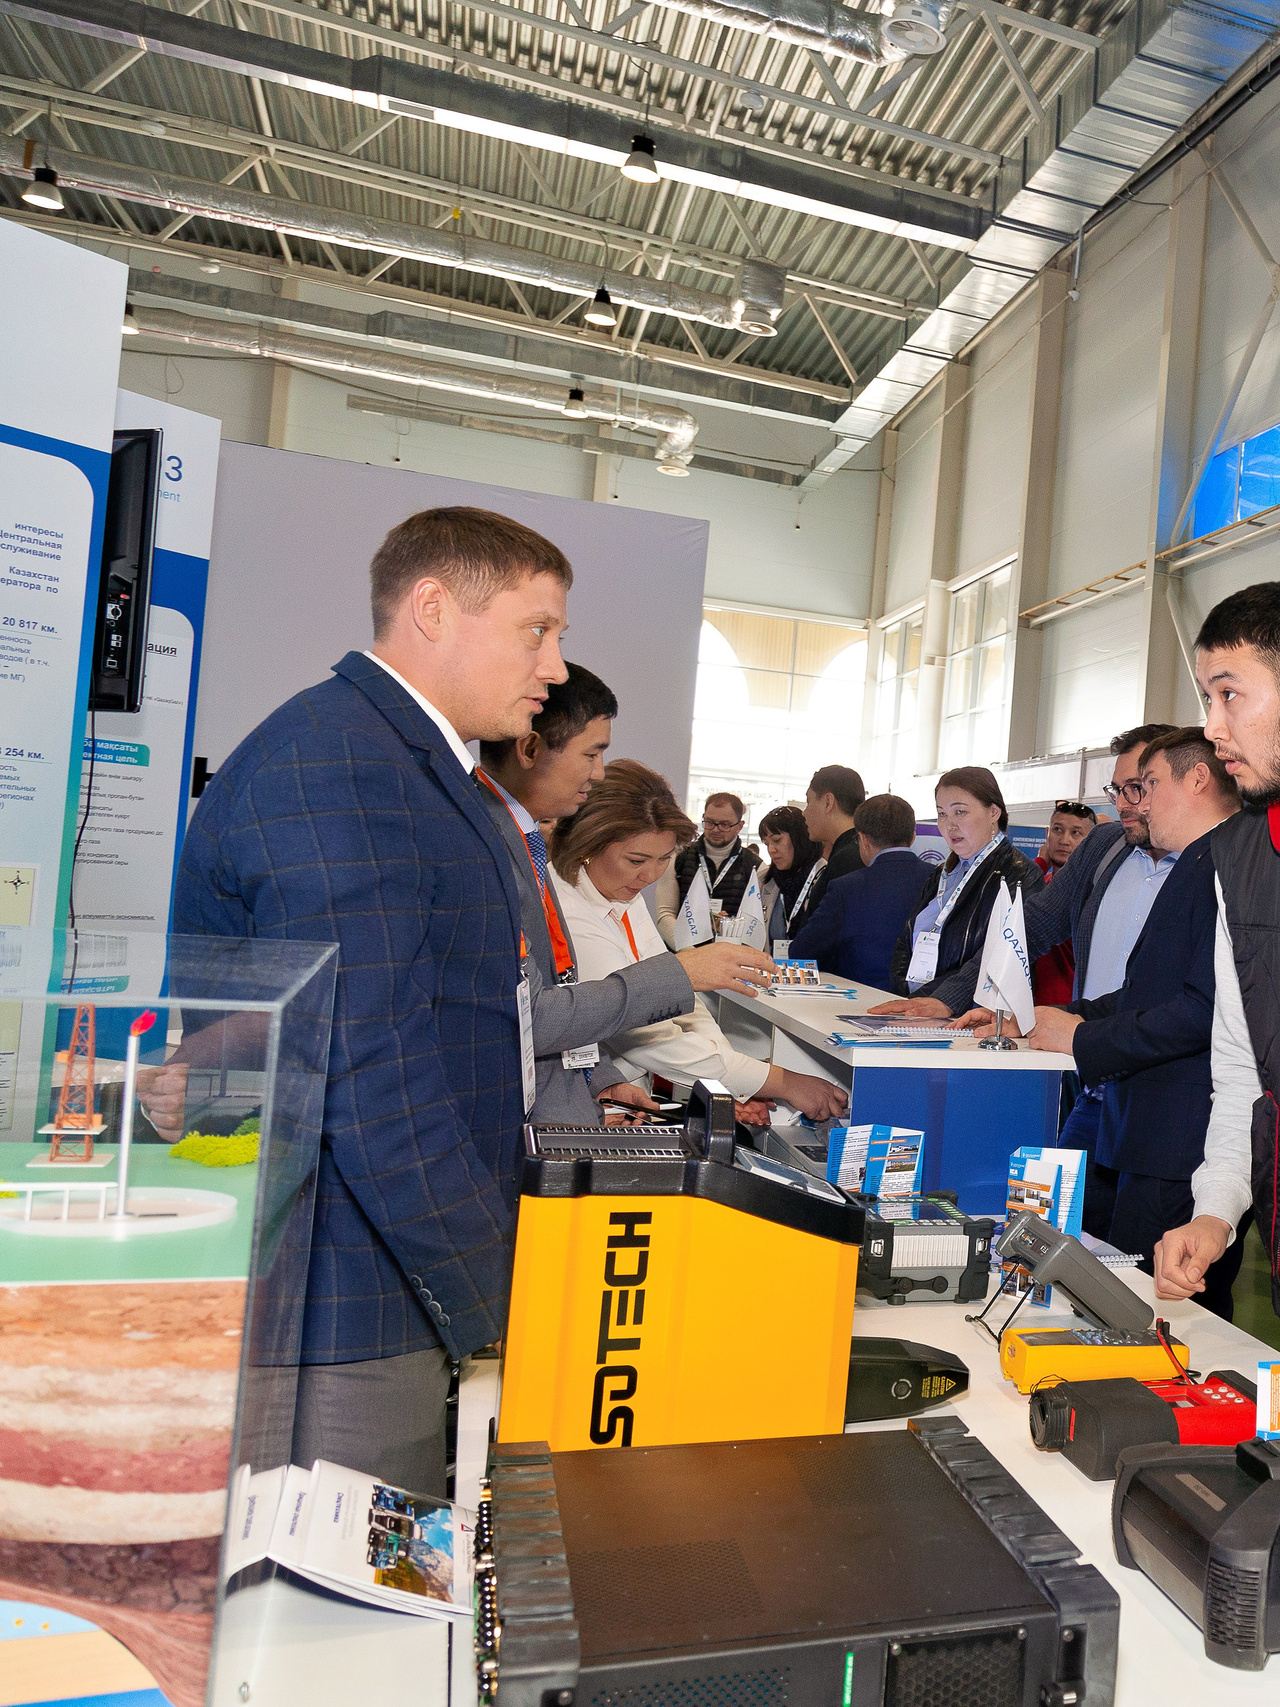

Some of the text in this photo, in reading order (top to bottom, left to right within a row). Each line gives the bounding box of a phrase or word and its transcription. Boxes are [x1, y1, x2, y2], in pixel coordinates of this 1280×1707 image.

[15, 523, 64, 539] интересы
[0, 543, 61, 560] служивание
[9, 566, 60, 583] Казахстан
[0, 577, 59, 594] ератора по
[2, 616, 58, 634] 20 817 км.
[0, 634, 32, 645] енность
[0, 644, 31, 654] альных
[96, 741, 138, 753] мақсаты
[27, 751, 45, 760] км.
[115, 755, 138, 764] цель
